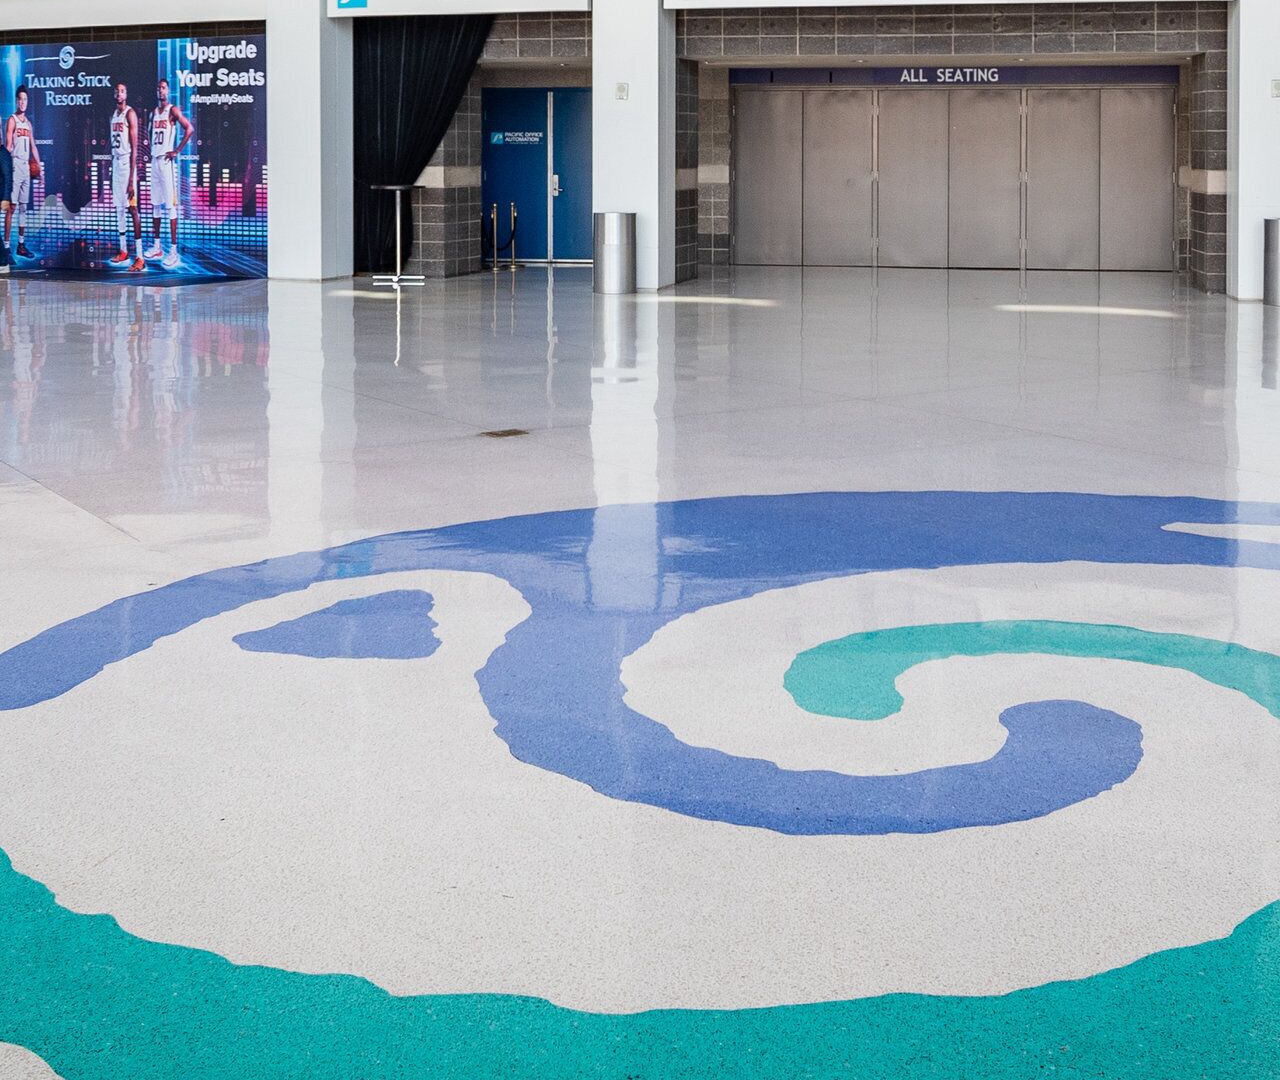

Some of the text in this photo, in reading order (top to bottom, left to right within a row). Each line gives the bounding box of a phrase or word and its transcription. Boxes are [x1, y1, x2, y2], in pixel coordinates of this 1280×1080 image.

[186, 40, 257, 64] Upgrade
[25, 71, 111, 89] TALKING STICK
[176, 67, 265, 88] Your Seats
[900, 68, 999, 82] ALL SEATING
